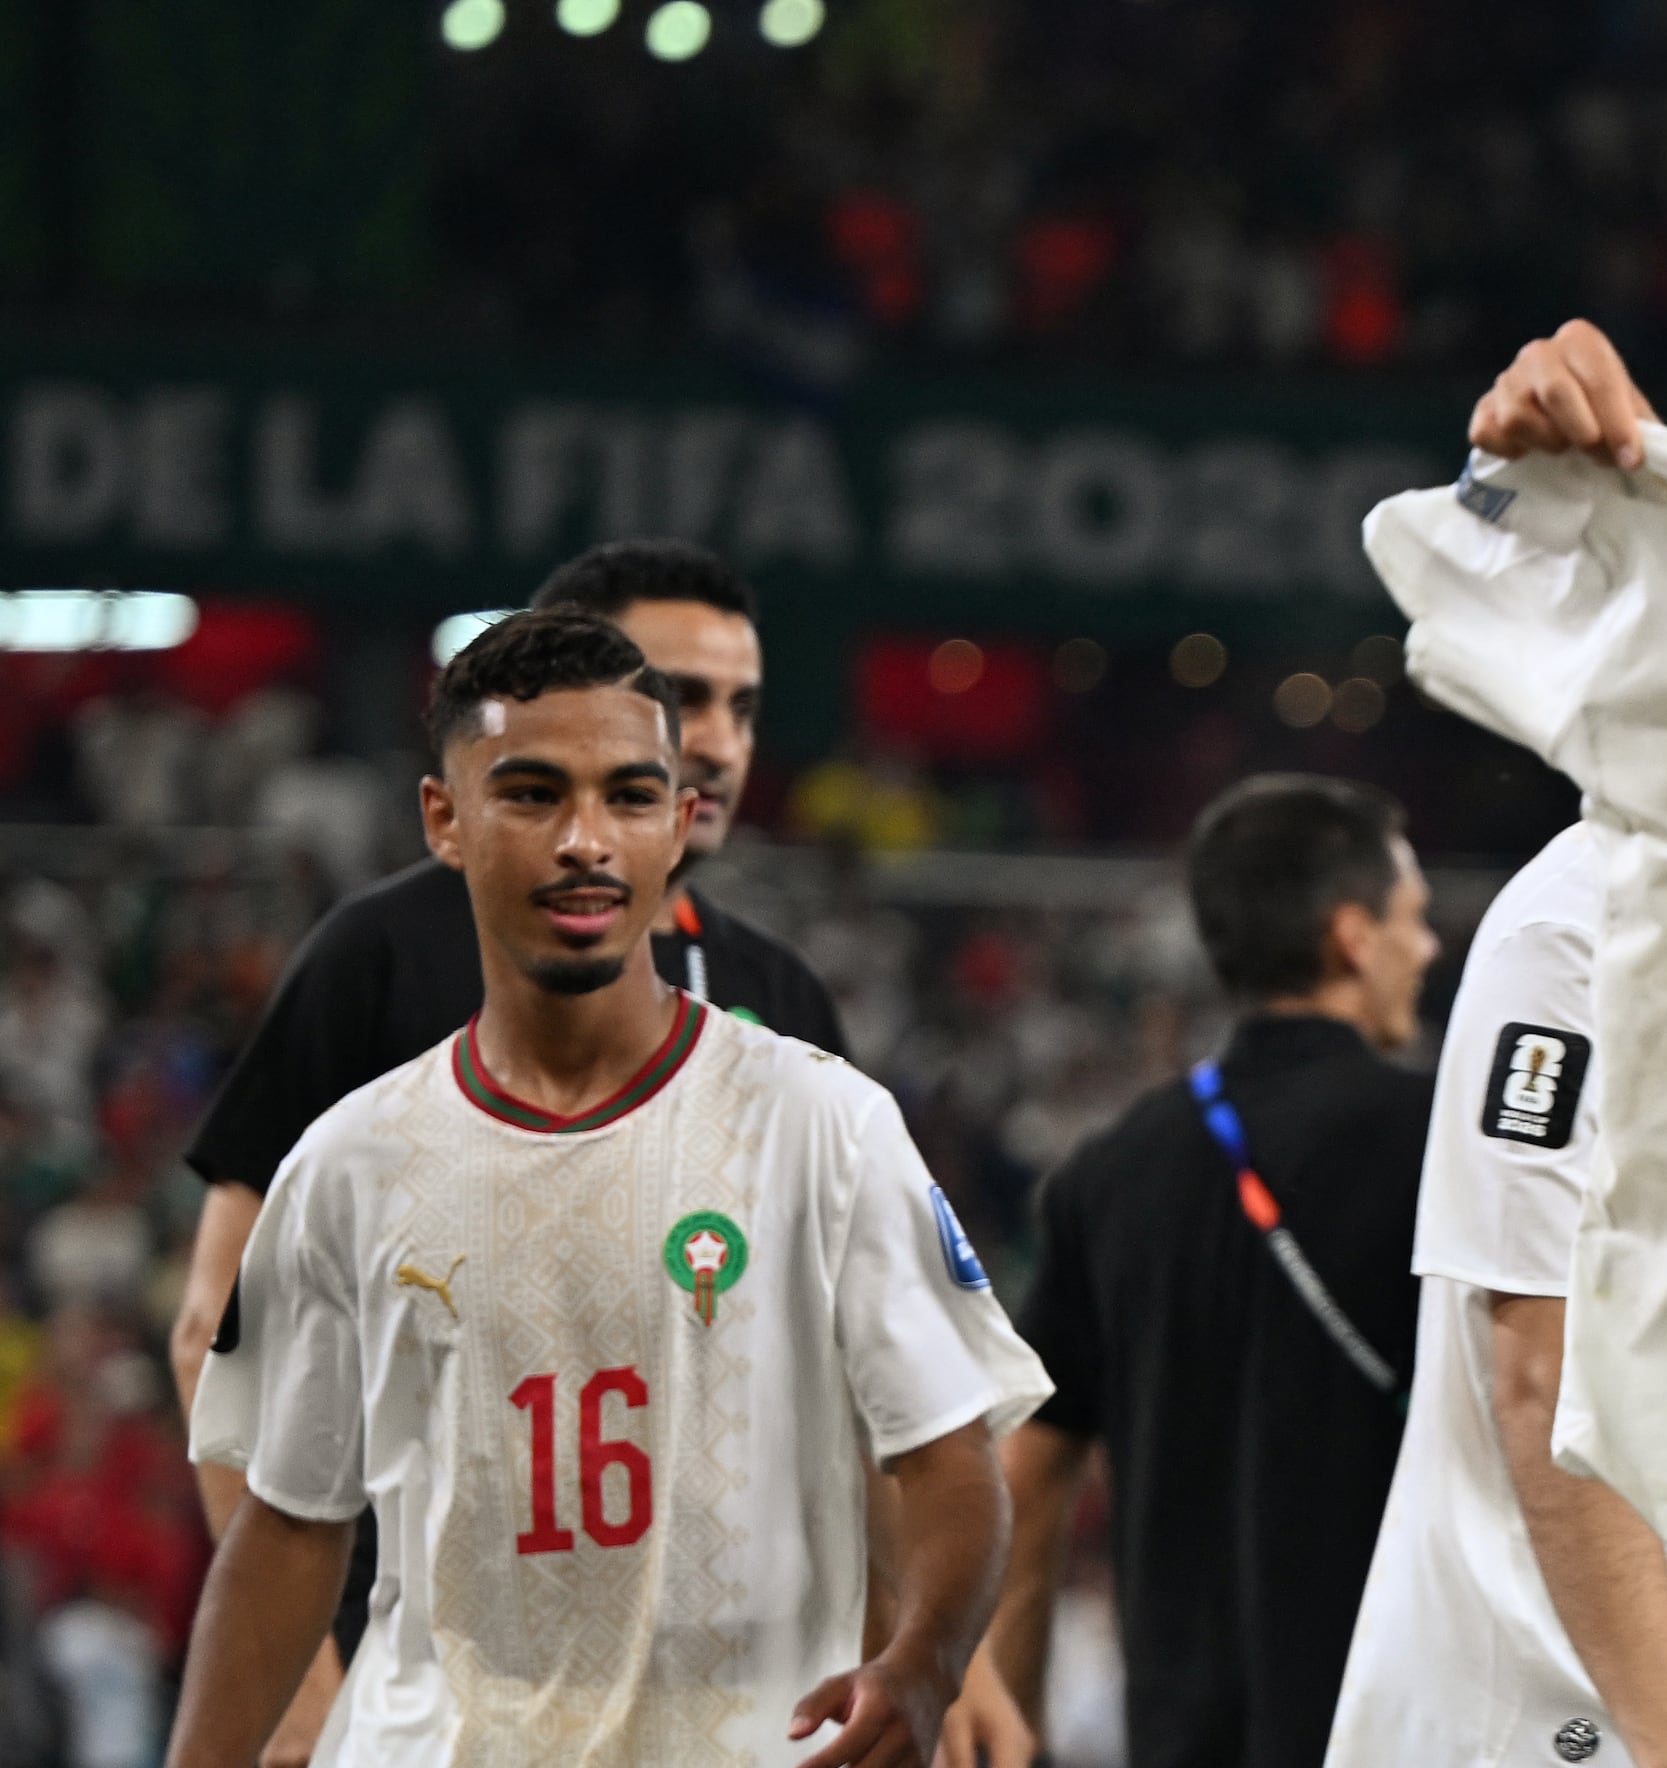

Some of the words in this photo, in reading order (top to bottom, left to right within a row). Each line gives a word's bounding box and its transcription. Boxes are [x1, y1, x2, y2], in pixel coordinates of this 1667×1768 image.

[12, 386, 222, 542] DE
[252, 390, 474, 552] LA
[497, 402, 855, 565] FIFA
[508, 1365, 652, 1555] 16
